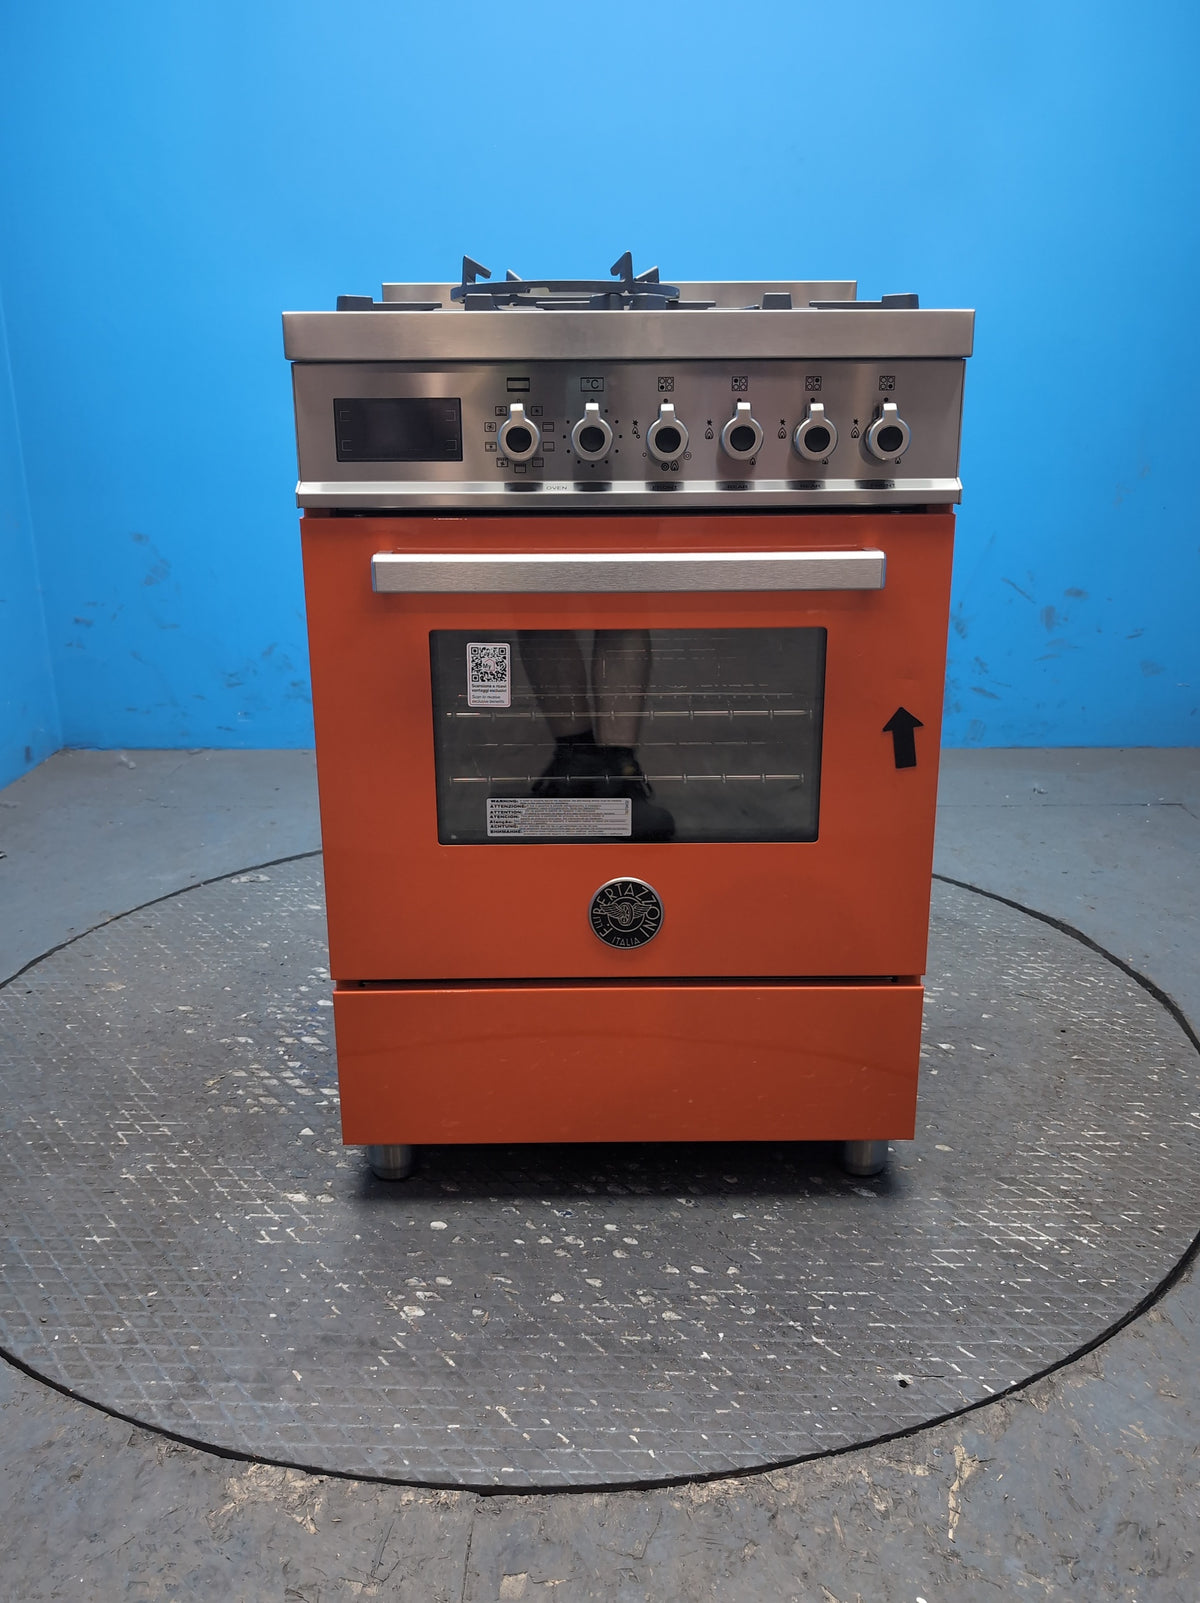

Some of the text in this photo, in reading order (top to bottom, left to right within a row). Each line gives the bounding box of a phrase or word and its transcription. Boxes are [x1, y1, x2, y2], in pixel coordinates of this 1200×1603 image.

[585, 379, 600, 390] °C
[593, 883, 660, 938] BERTAZZONI
[611, 936, 640, 946] ITALIA
